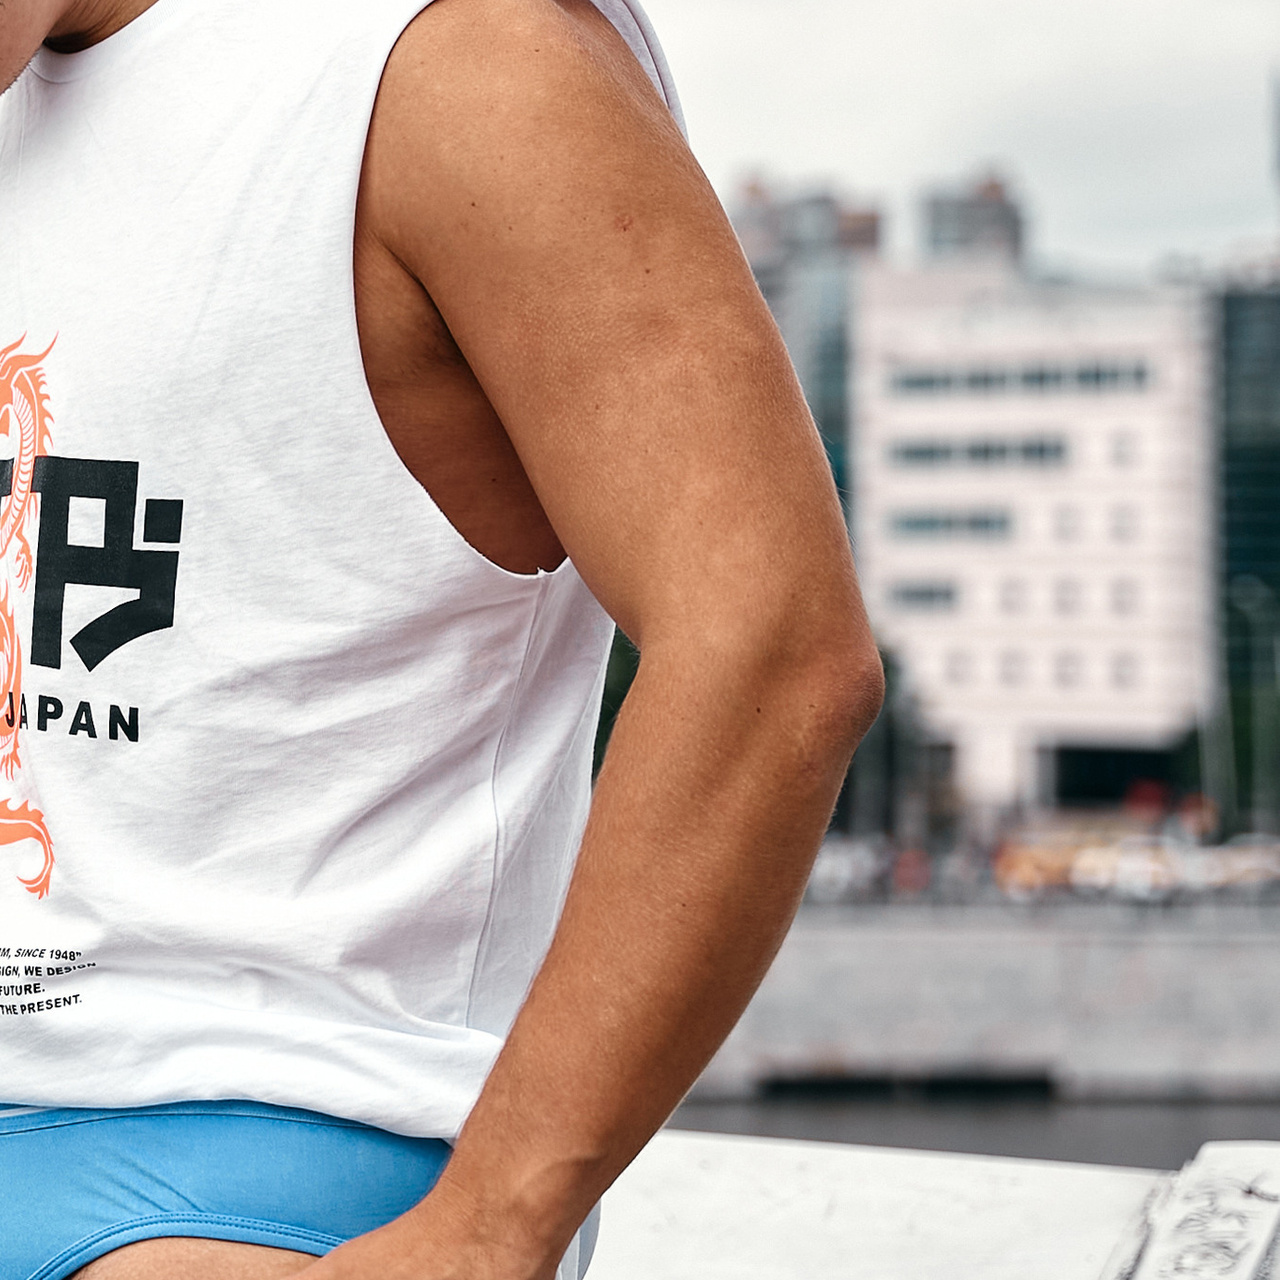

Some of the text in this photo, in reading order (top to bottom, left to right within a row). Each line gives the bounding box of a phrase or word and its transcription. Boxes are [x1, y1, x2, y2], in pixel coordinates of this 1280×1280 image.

[14, 948, 46, 958] SINCE
[24, 966, 42, 976] WE
[0, 1004, 18, 1015] THE
[20, 994, 82, 1015] PRESENT.
